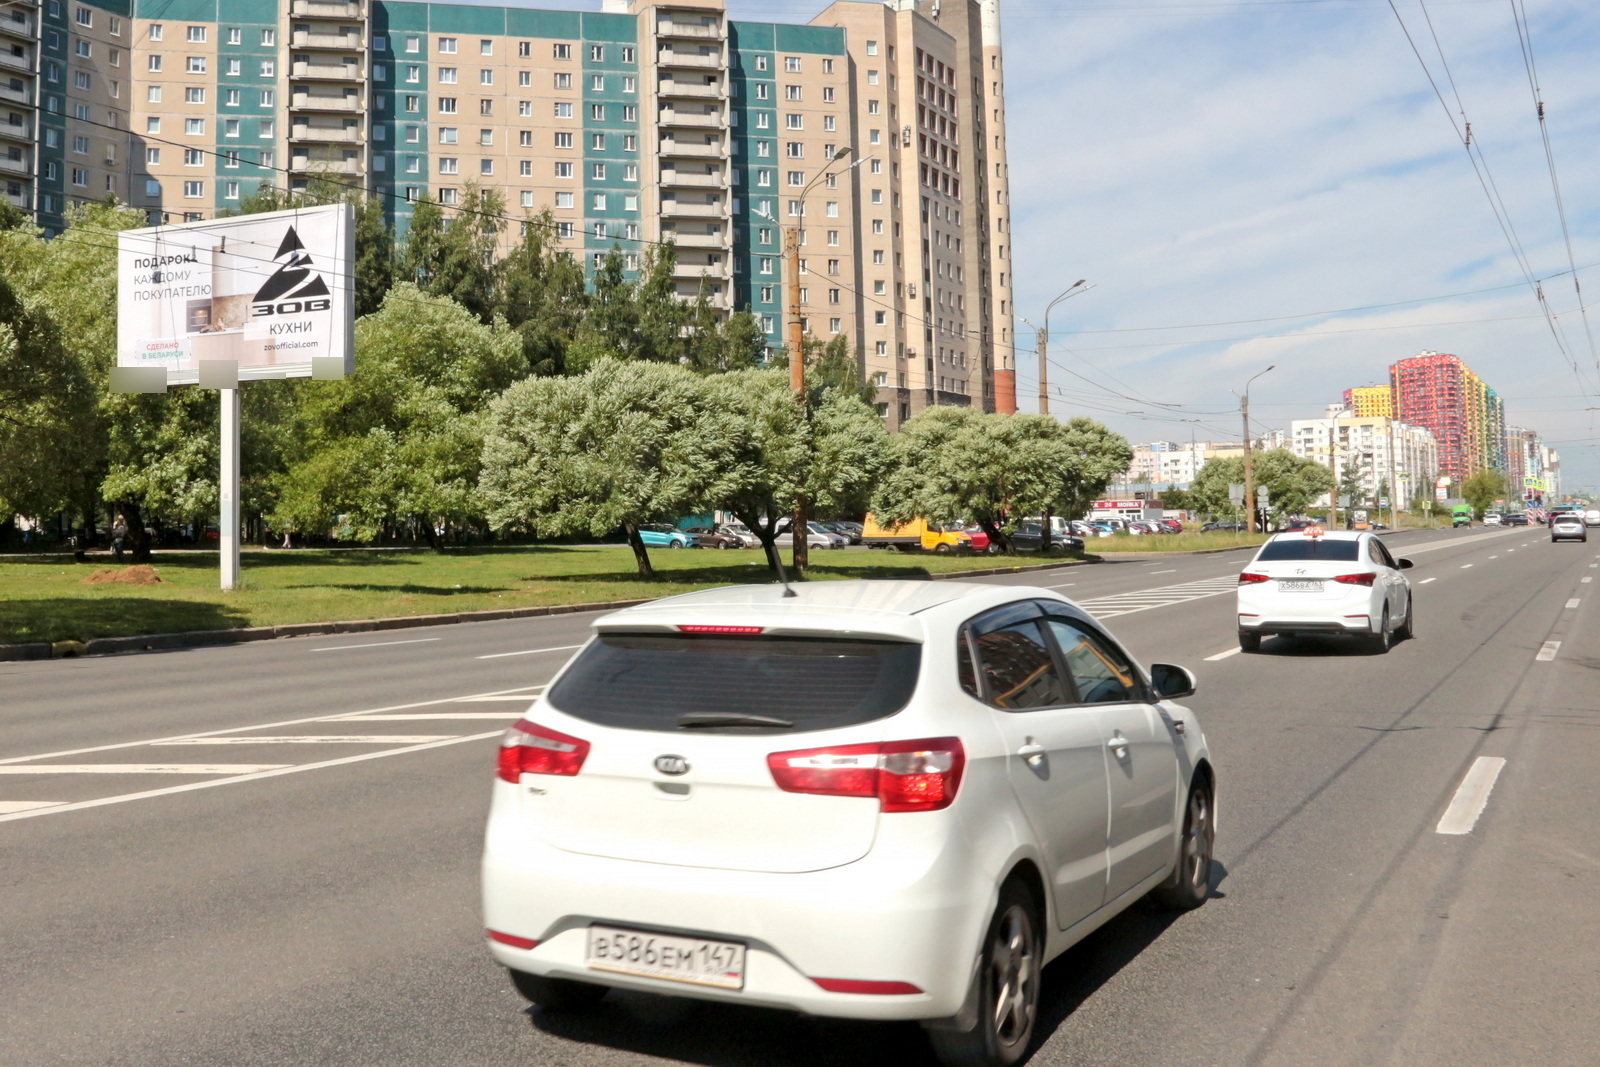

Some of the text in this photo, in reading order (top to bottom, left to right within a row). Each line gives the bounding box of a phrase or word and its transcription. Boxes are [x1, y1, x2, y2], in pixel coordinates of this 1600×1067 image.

[134, 254, 190, 269] ПОДАРОК
[134, 284, 212, 301] ПОКУПАТЕЛЮ
[252, 299, 331, 317] ЗОВ
[269, 321, 313, 336] КУХНИ
[146, 342, 180, 351] СДЕЛАНО
[264, 341, 319, 351] zovofficial.com
[142, 350, 184, 360] В БЕЛАРУСИ
